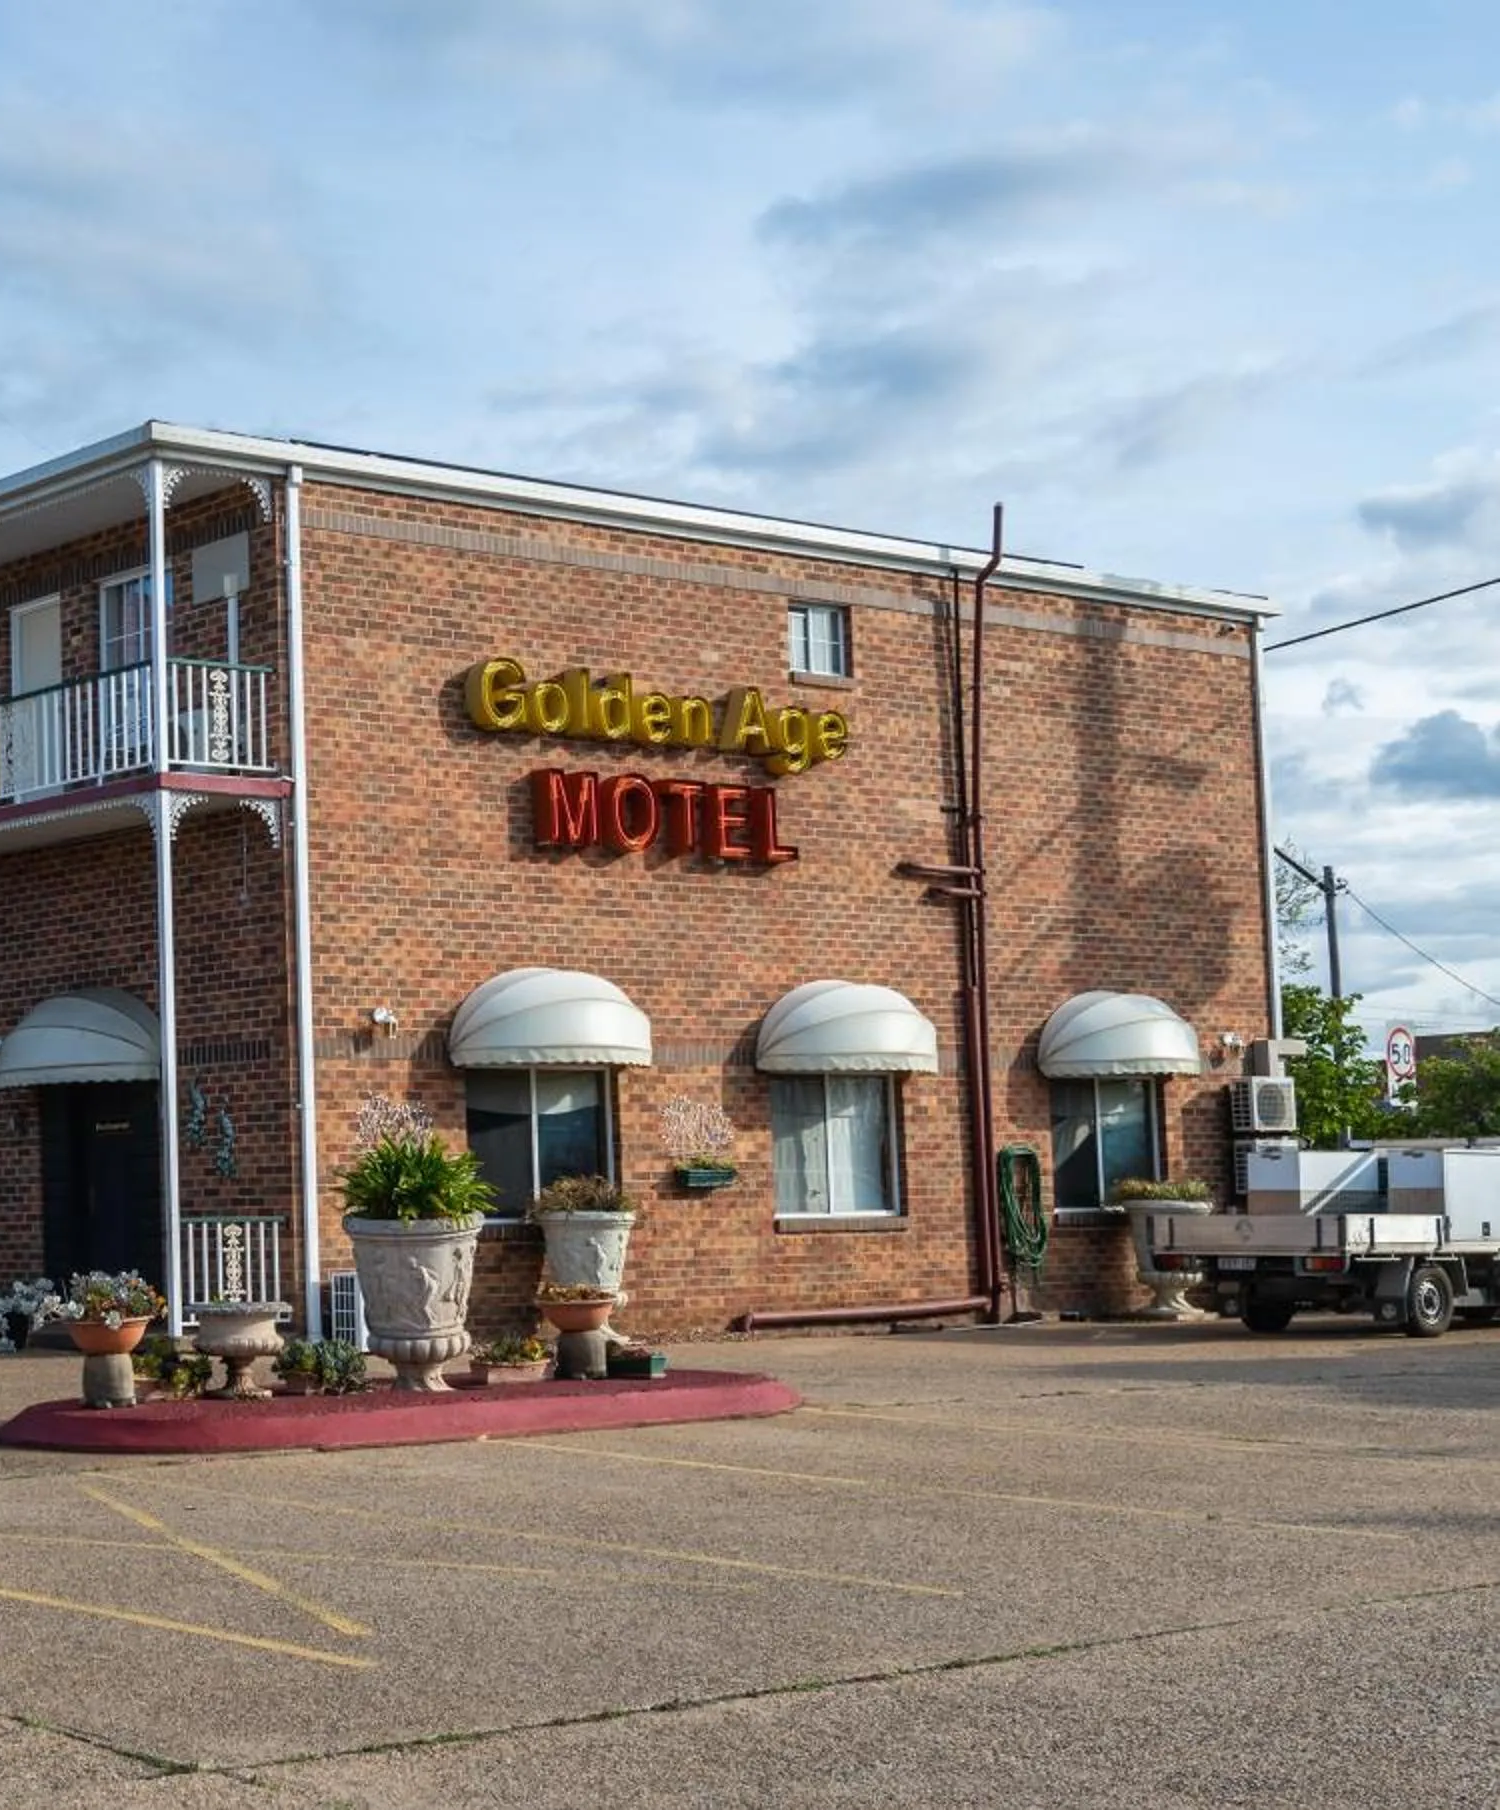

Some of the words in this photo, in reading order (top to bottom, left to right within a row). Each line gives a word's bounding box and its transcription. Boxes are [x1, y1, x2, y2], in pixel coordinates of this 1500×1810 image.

[467, 656, 713, 747] Golden
[721, 685, 849, 776] Age
[533, 767, 799, 863] MOTEL
[1391, 1043, 1411, 1065] 50
